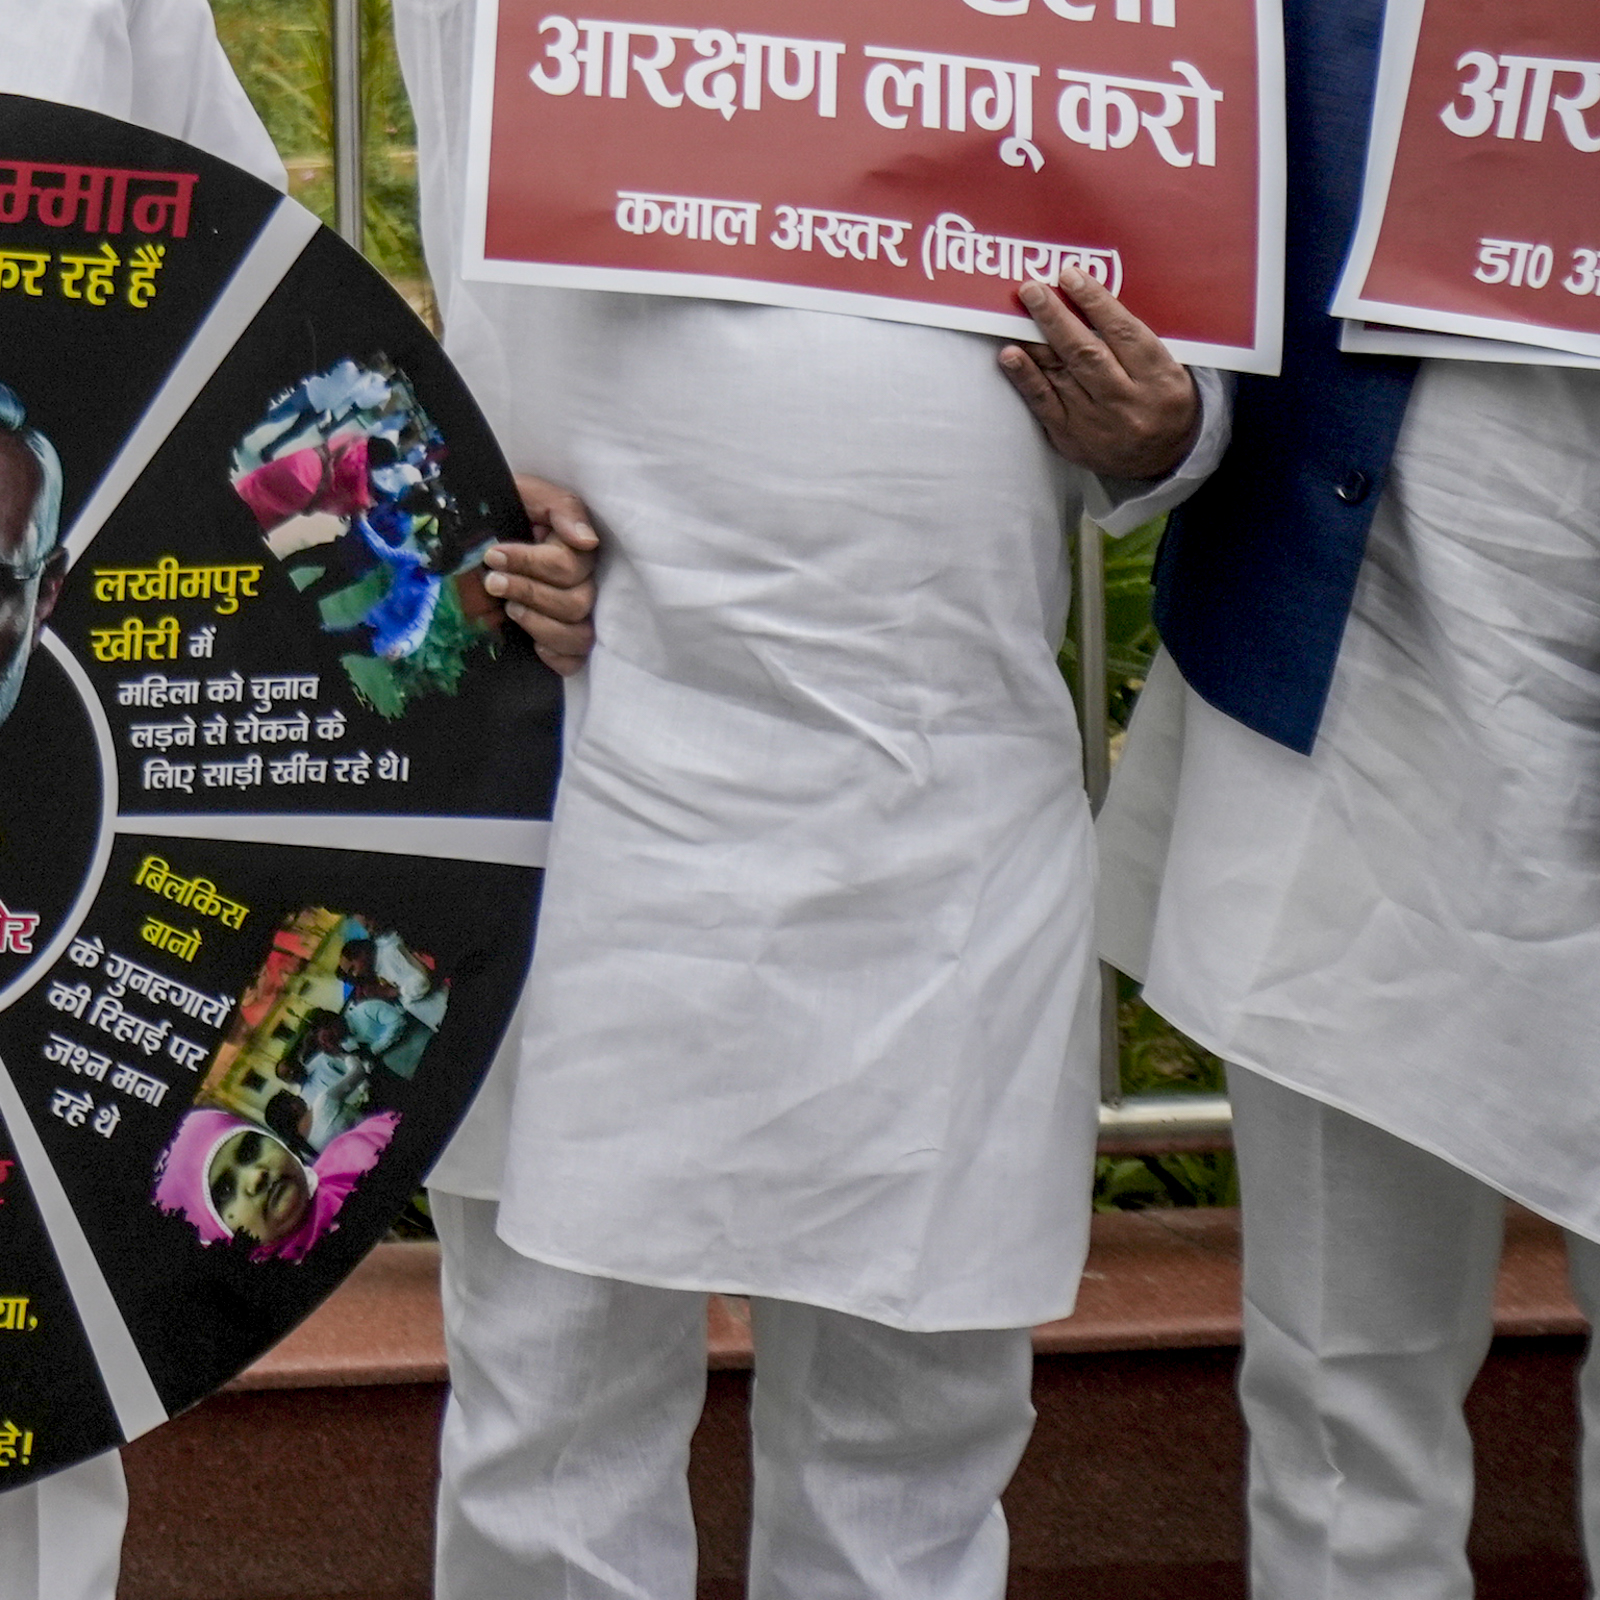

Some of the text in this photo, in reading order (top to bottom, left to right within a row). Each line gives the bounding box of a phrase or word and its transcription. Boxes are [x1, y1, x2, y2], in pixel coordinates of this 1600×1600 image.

[529, 15, 1223, 172] आरक्षण लागू करो
[616, 190, 1122, 300] कमाल अख्तर (विधायक)
[94, 557, 263, 614] लखीमपुर
[91, 616, 216, 661] खीरी में
[120, 671, 320, 713] महिला को चुनाव
[143, 757, 196, 793] लिए
[202, 753, 263, 790] साड़ी
[269, 751, 328, 784] खींच
[333, 750, 372, 784] रहे
